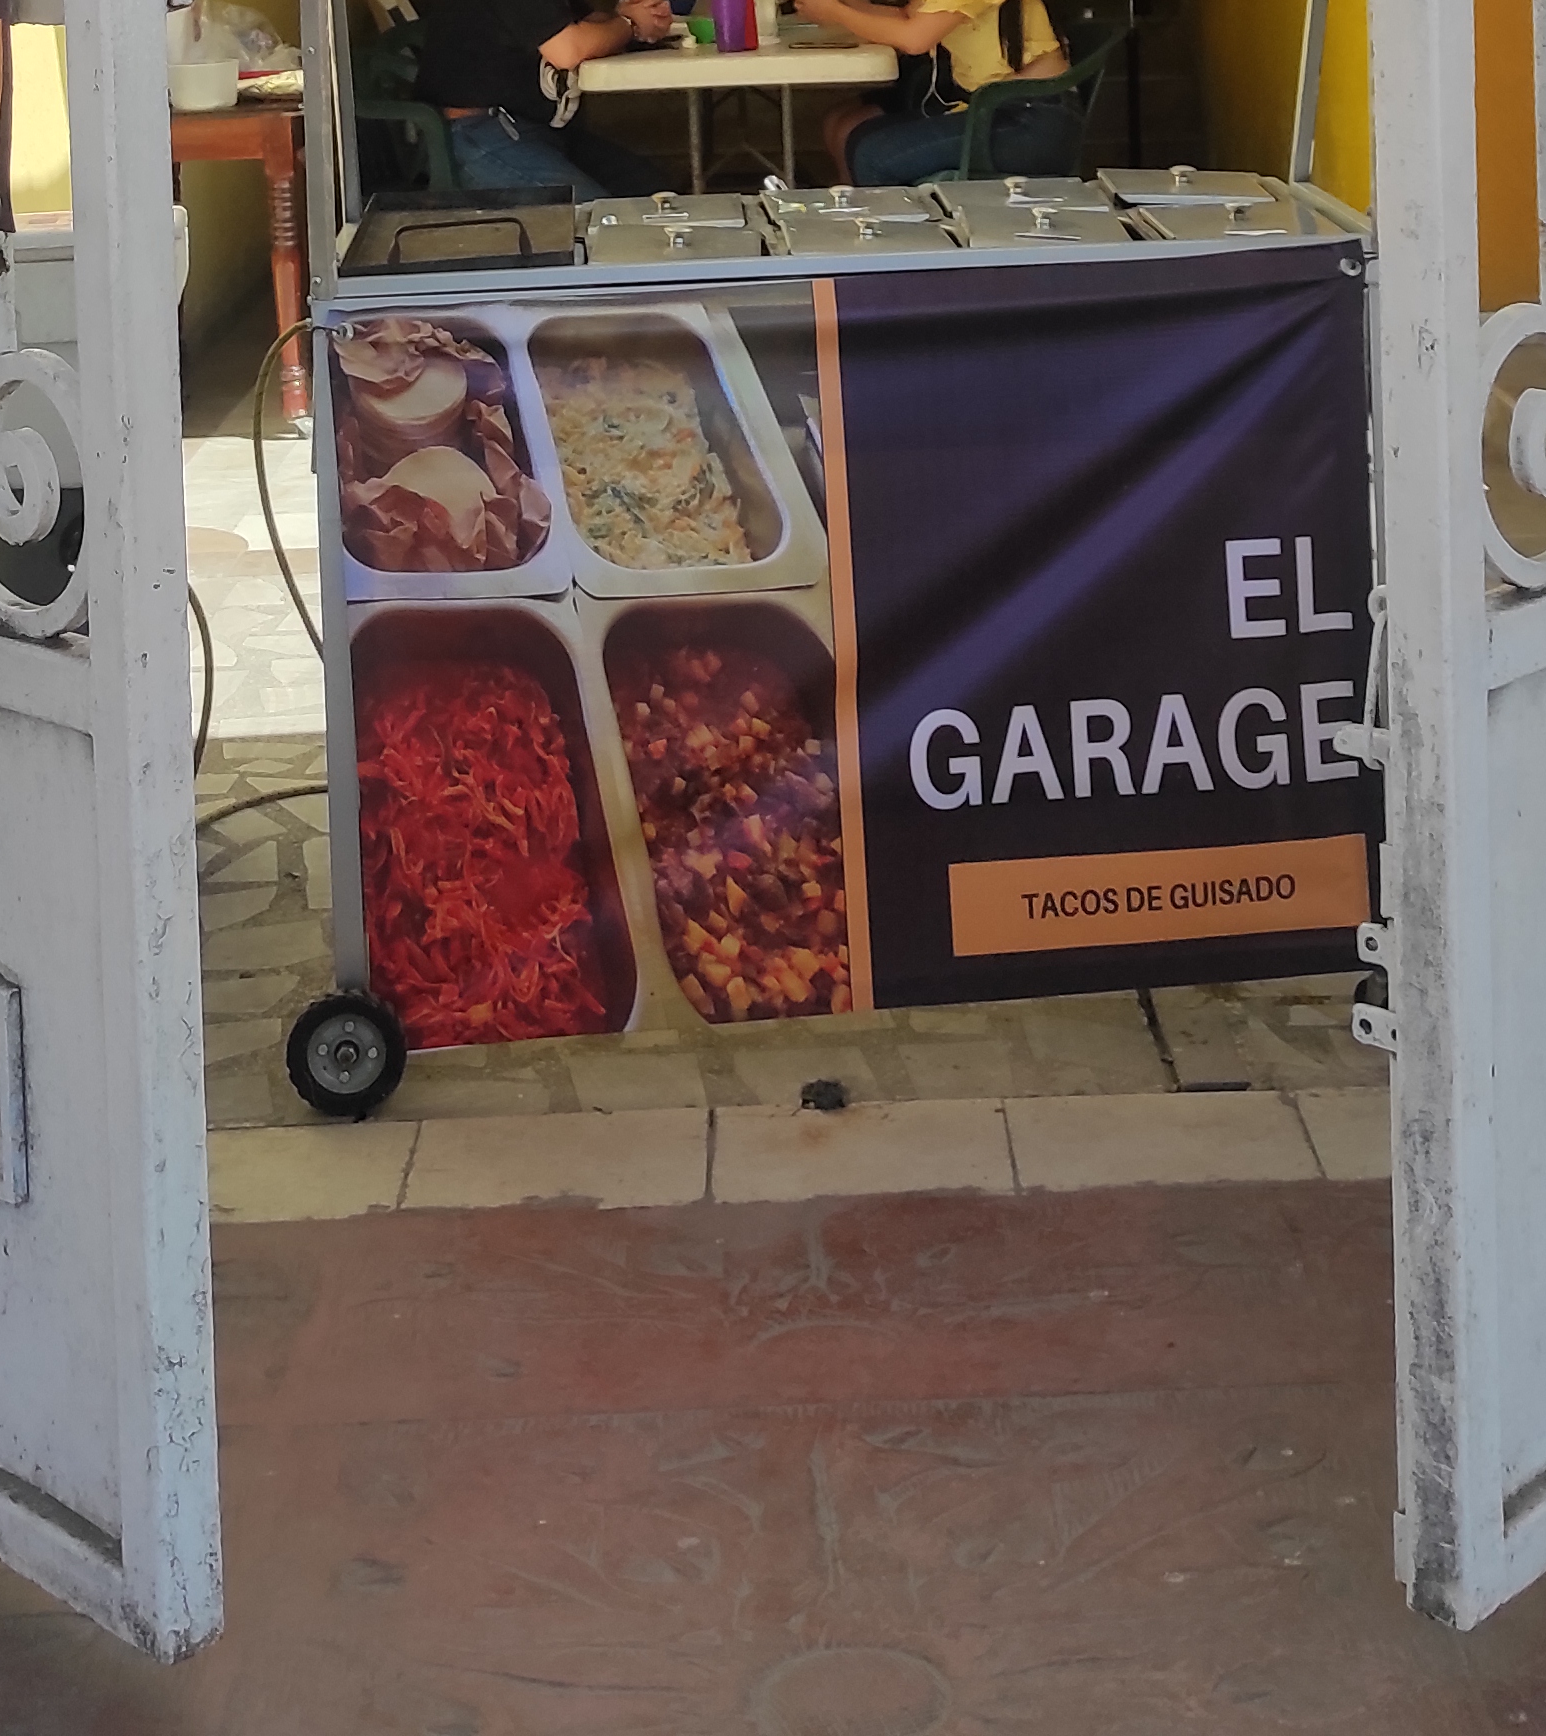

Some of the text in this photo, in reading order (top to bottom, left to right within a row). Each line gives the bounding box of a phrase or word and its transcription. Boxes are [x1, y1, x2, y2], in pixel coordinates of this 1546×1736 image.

[1225, 536, 1353, 640] EL
[909, 680, 1360, 811] GARAGE
[1021, 874, 1297, 920] TACOS DE GUISADO
